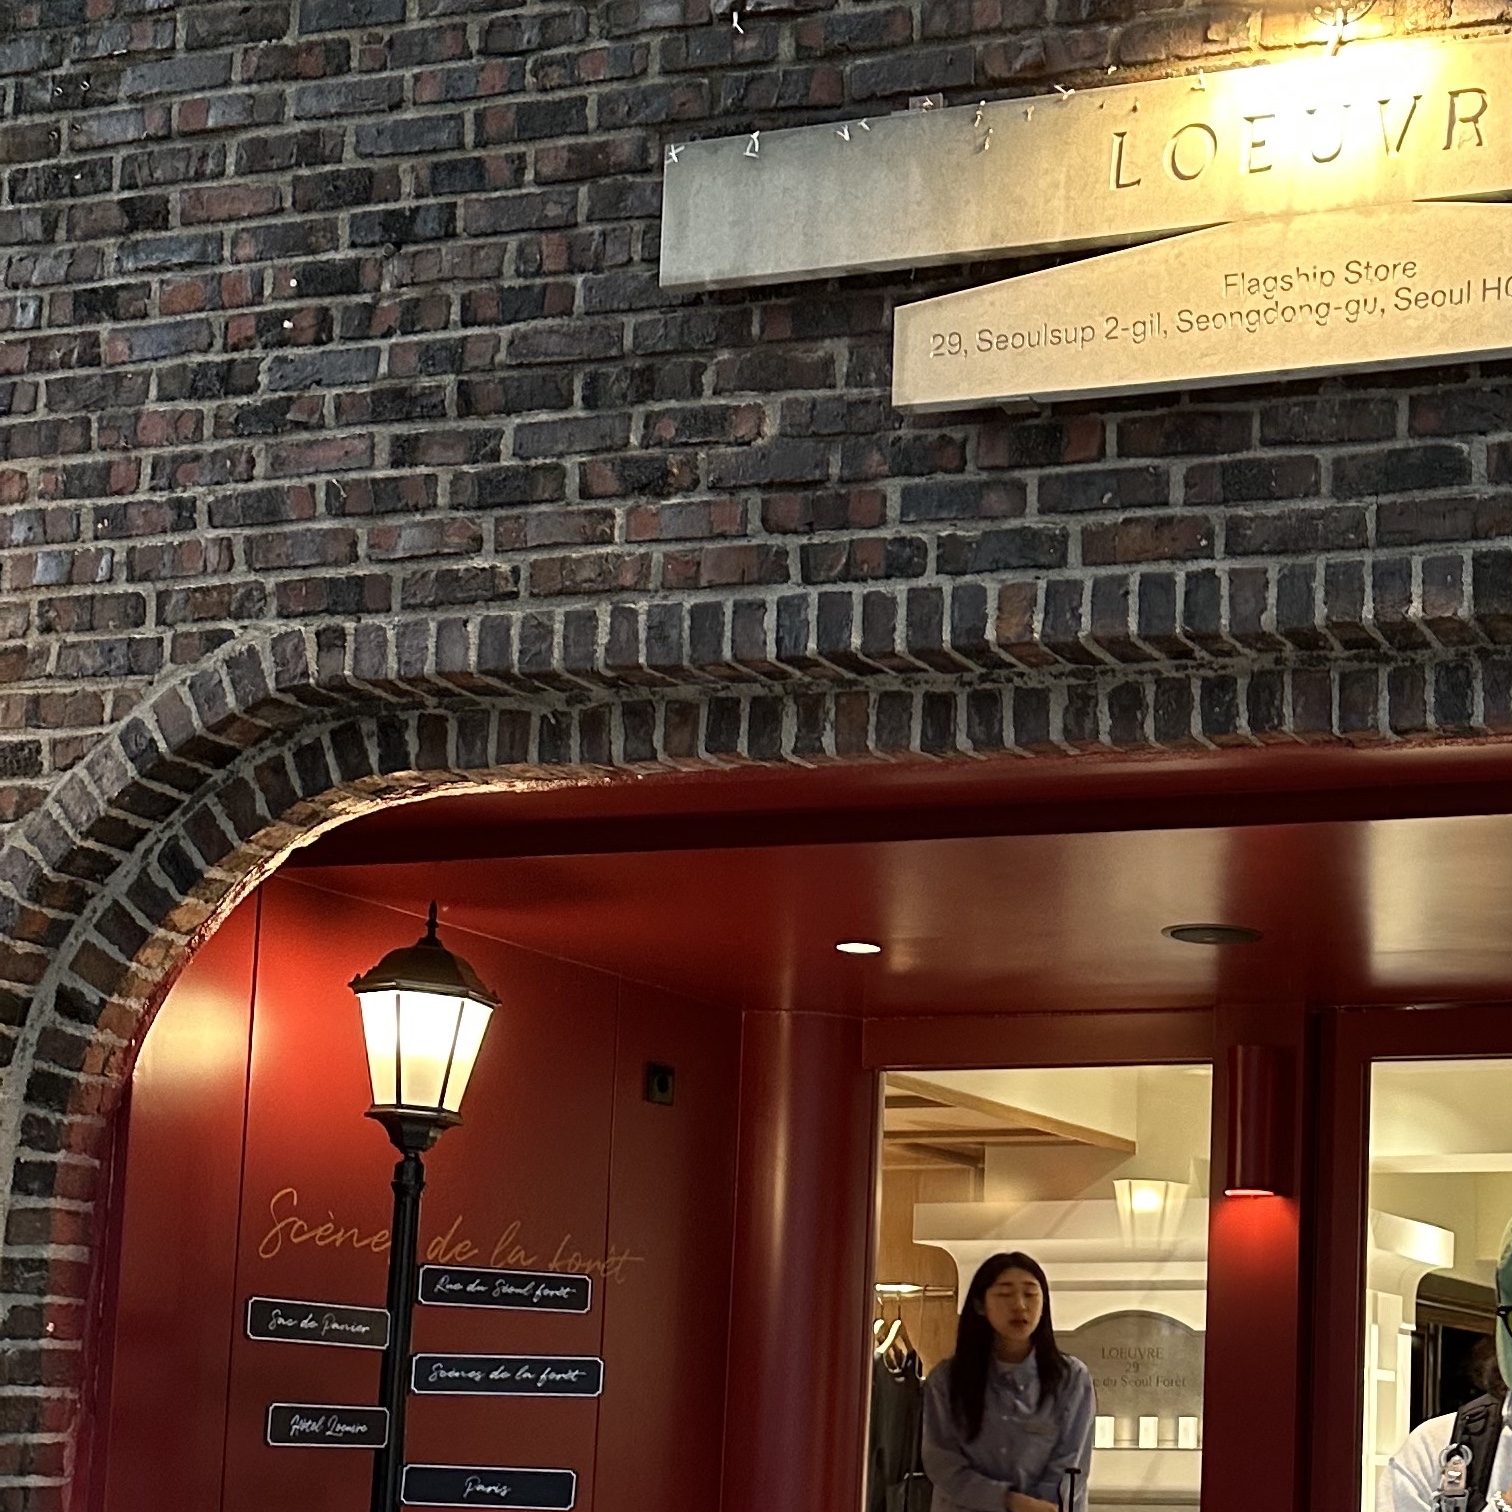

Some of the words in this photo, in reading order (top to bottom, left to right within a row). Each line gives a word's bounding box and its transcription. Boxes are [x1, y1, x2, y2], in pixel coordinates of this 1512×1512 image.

[1223, 266, 1336, 301] Flagship
[1344, 259, 1418, 285] Store
[930, 332, 969, 360] 29,
[975, 322, 1097, 354] Seoulsup
[1104, 313, 1169, 345] 2-gil,
[1175, 299, 1387, 334] Seongdong-gu,
[1393, 279, 1472, 312] Seoul
[427, 1215, 479, 1263] de
[491, 1220, 538, 1267] la
[1101, 1346, 1164, 1360] LOEUVRE
[1124, 1361, 1140, 1374] 29
[462, 1475, 511, 1499] Paris
